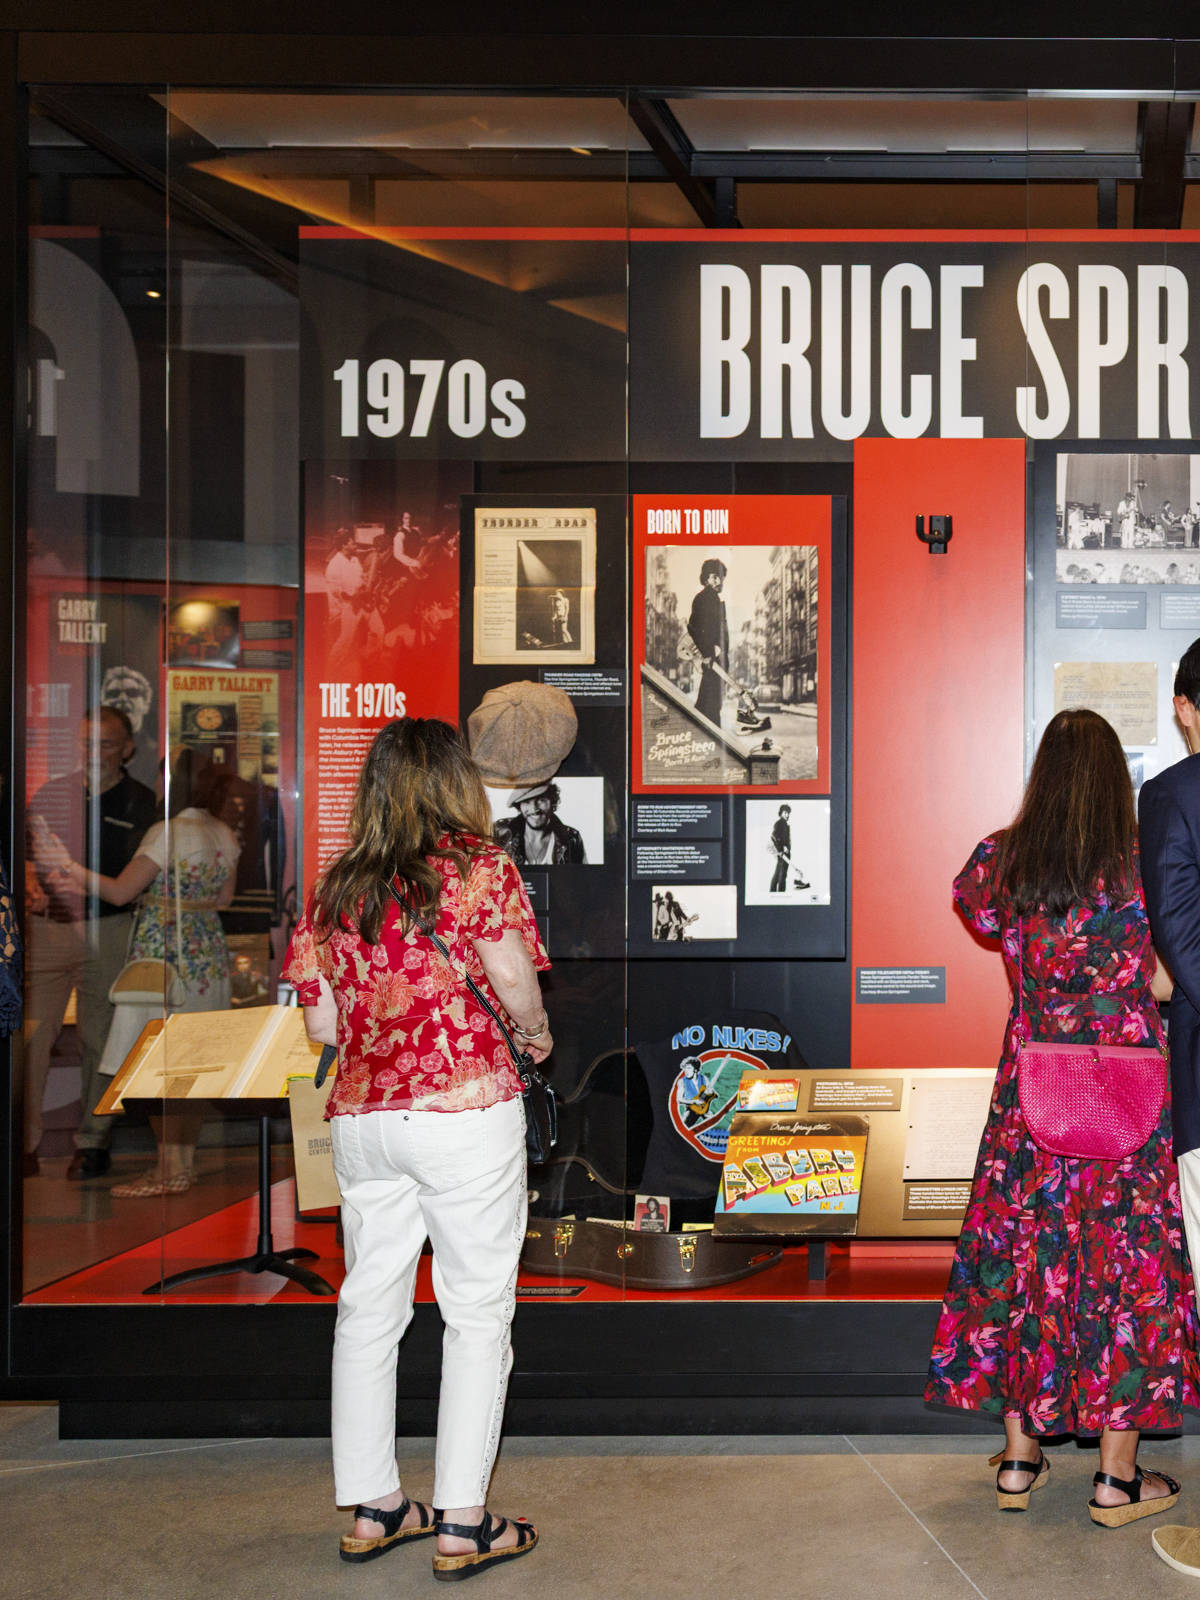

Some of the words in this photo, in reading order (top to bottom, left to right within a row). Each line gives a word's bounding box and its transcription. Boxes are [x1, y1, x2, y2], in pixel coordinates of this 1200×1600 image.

[700, 262, 984, 440] BRUCE
[333, 358, 526, 439] 1970s
[482, 518, 538, 528] THUNDER
[556, 518, 588, 528] ROAD
[647, 509, 681, 534] BORN
[684, 509, 700, 534] TO
[703, 509, 729, 534] RUN
[58, 599, 98, 620] GARRY
[58, 622, 108, 644] TALLENT
[172, 676, 214, 692] GARRY
[218, 676, 273, 692] TALLENT
[319, 683, 352, 718] THE
[354, 683, 406, 718] 1970s
[656, 732, 692, 745] Bruce
[648, 741, 716, 760] Springsteen
[672, 1025, 705, 1050] NO
[712, 1025, 792, 1054] NUKES!
[729, 1137, 795, 1146] GREETINGS
[723, 1149, 856, 1211] ASBURY
[784, 1176, 858, 1207] PARK
